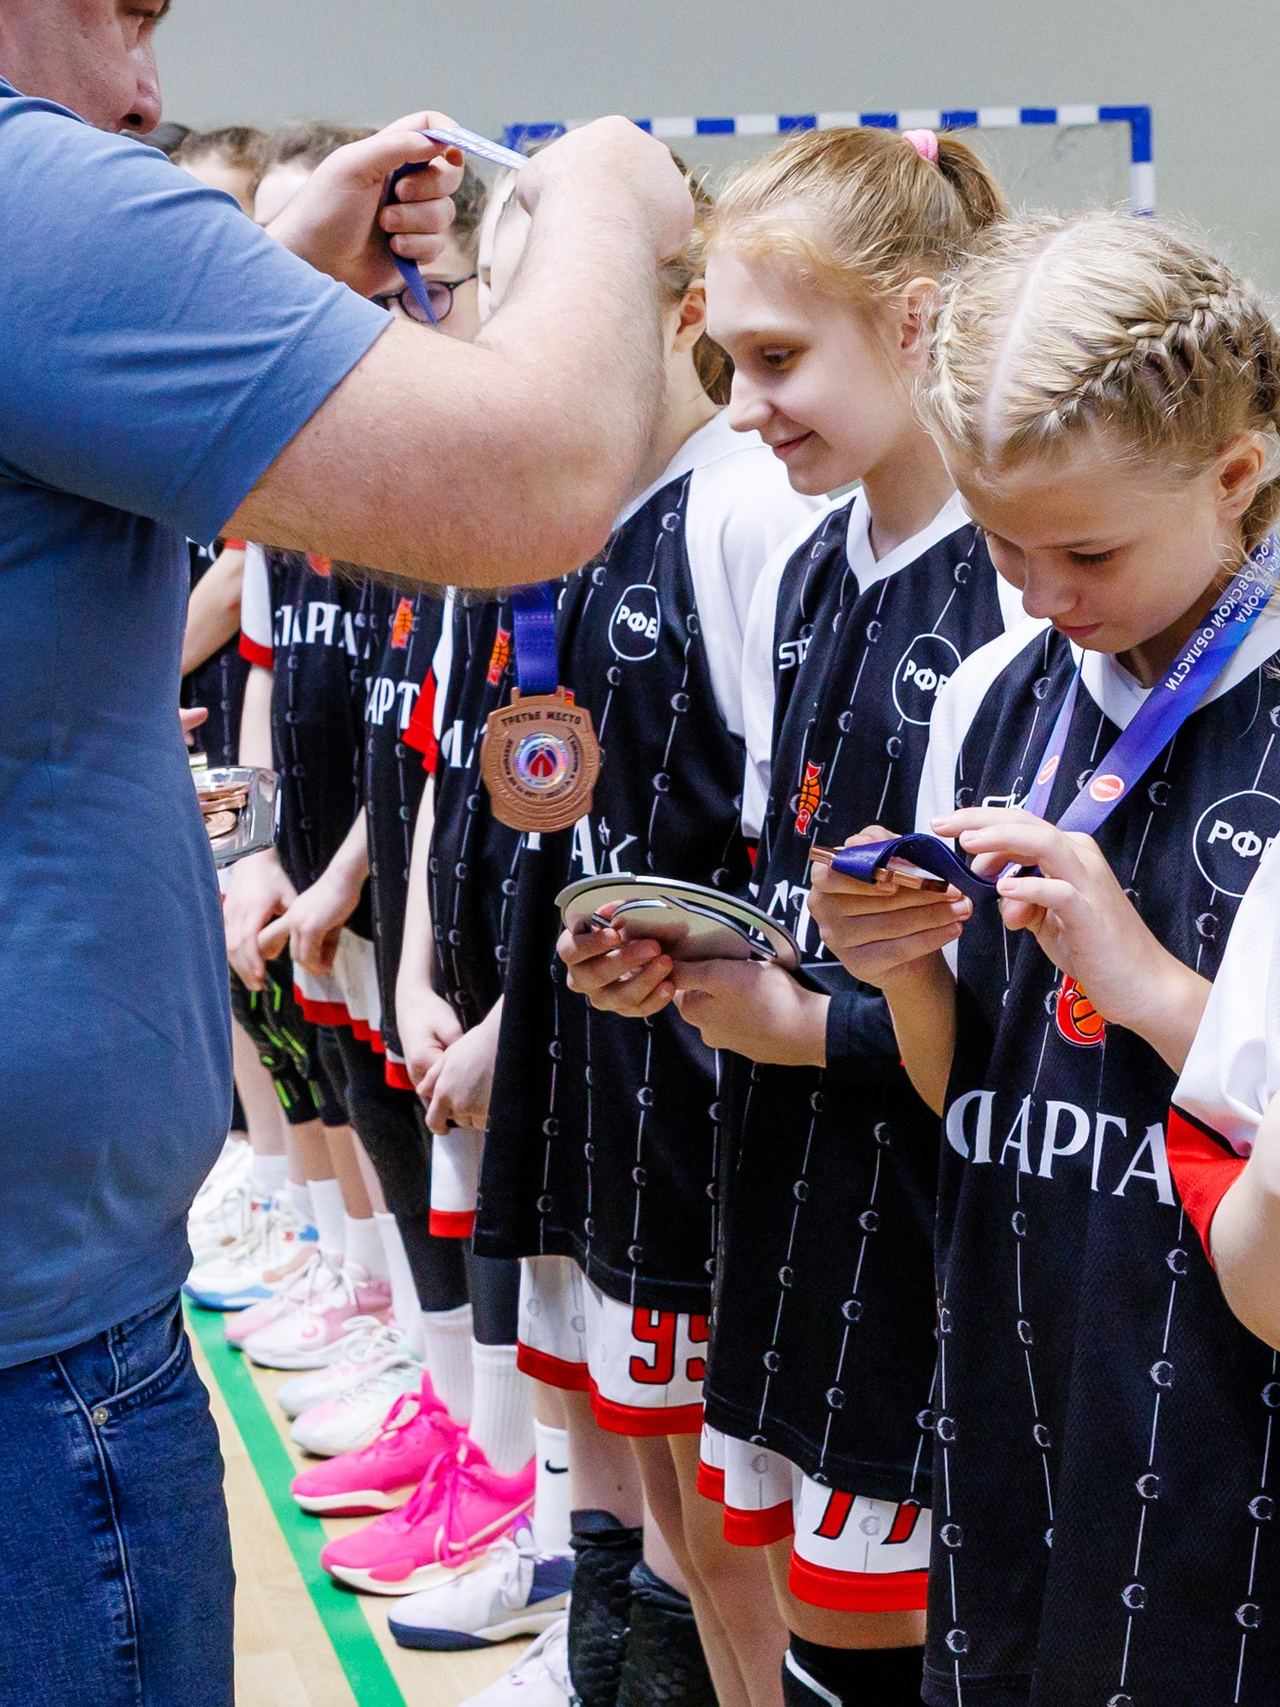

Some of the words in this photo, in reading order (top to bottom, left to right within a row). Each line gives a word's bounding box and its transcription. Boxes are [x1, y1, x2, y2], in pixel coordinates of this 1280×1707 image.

[615, 604, 657, 640] РФБ
[778, 634, 813, 670] ST
[1165, 626, 1215, 691] ОБЛАСТИ
[501, 710, 541, 727] ТРЕТЬЕ
[546, 711, 582, 725] МЕСТО
